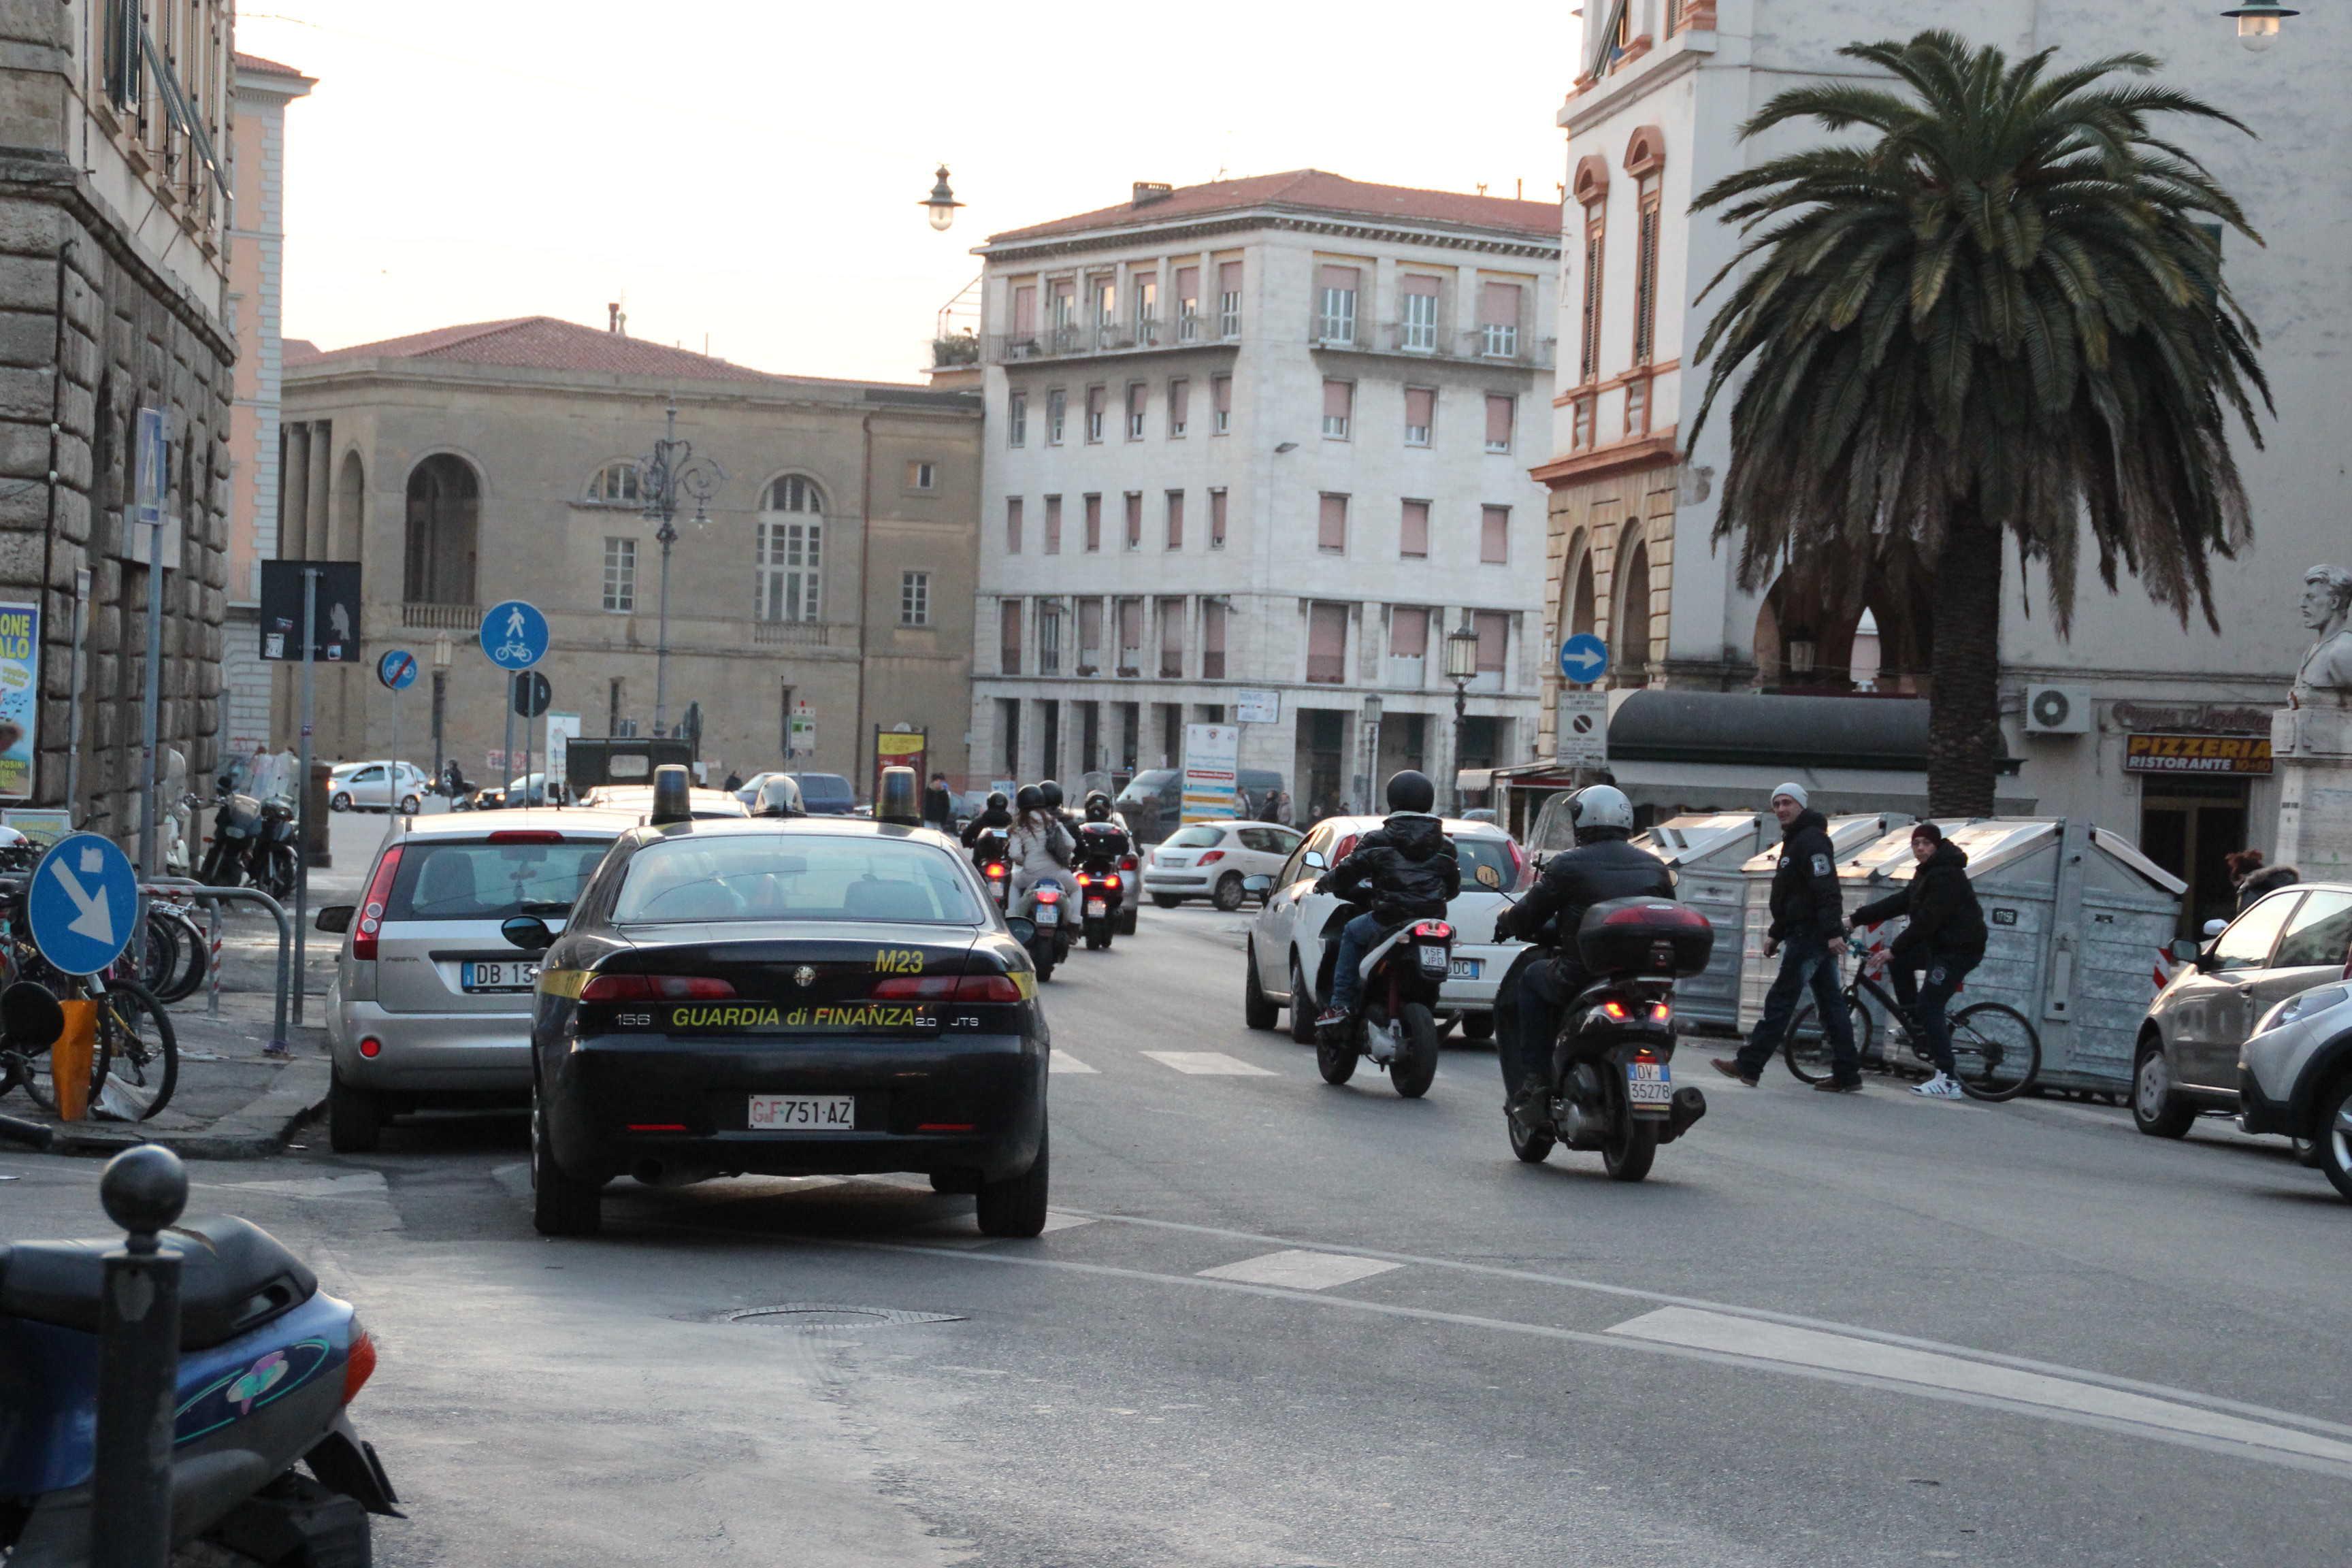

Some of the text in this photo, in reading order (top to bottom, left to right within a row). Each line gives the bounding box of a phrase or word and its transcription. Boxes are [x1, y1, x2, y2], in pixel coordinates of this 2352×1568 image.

[2129, 736, 2272, 759] PIZZERIA
[2128, 755, 2232, 771] RISTORANTE
[875, 949, 924, 973] M23
[477, 964, 501, 984] DB
[615, 1014, 651, 1026] 156
[672, 1007, 915, 1026] GUARDIA di FINANZA
[950, 1017, 979, 1026] JTS
[1637, 1065, 1652, 1079] DV
[1631, 1083, 1670, 1099] 35278
